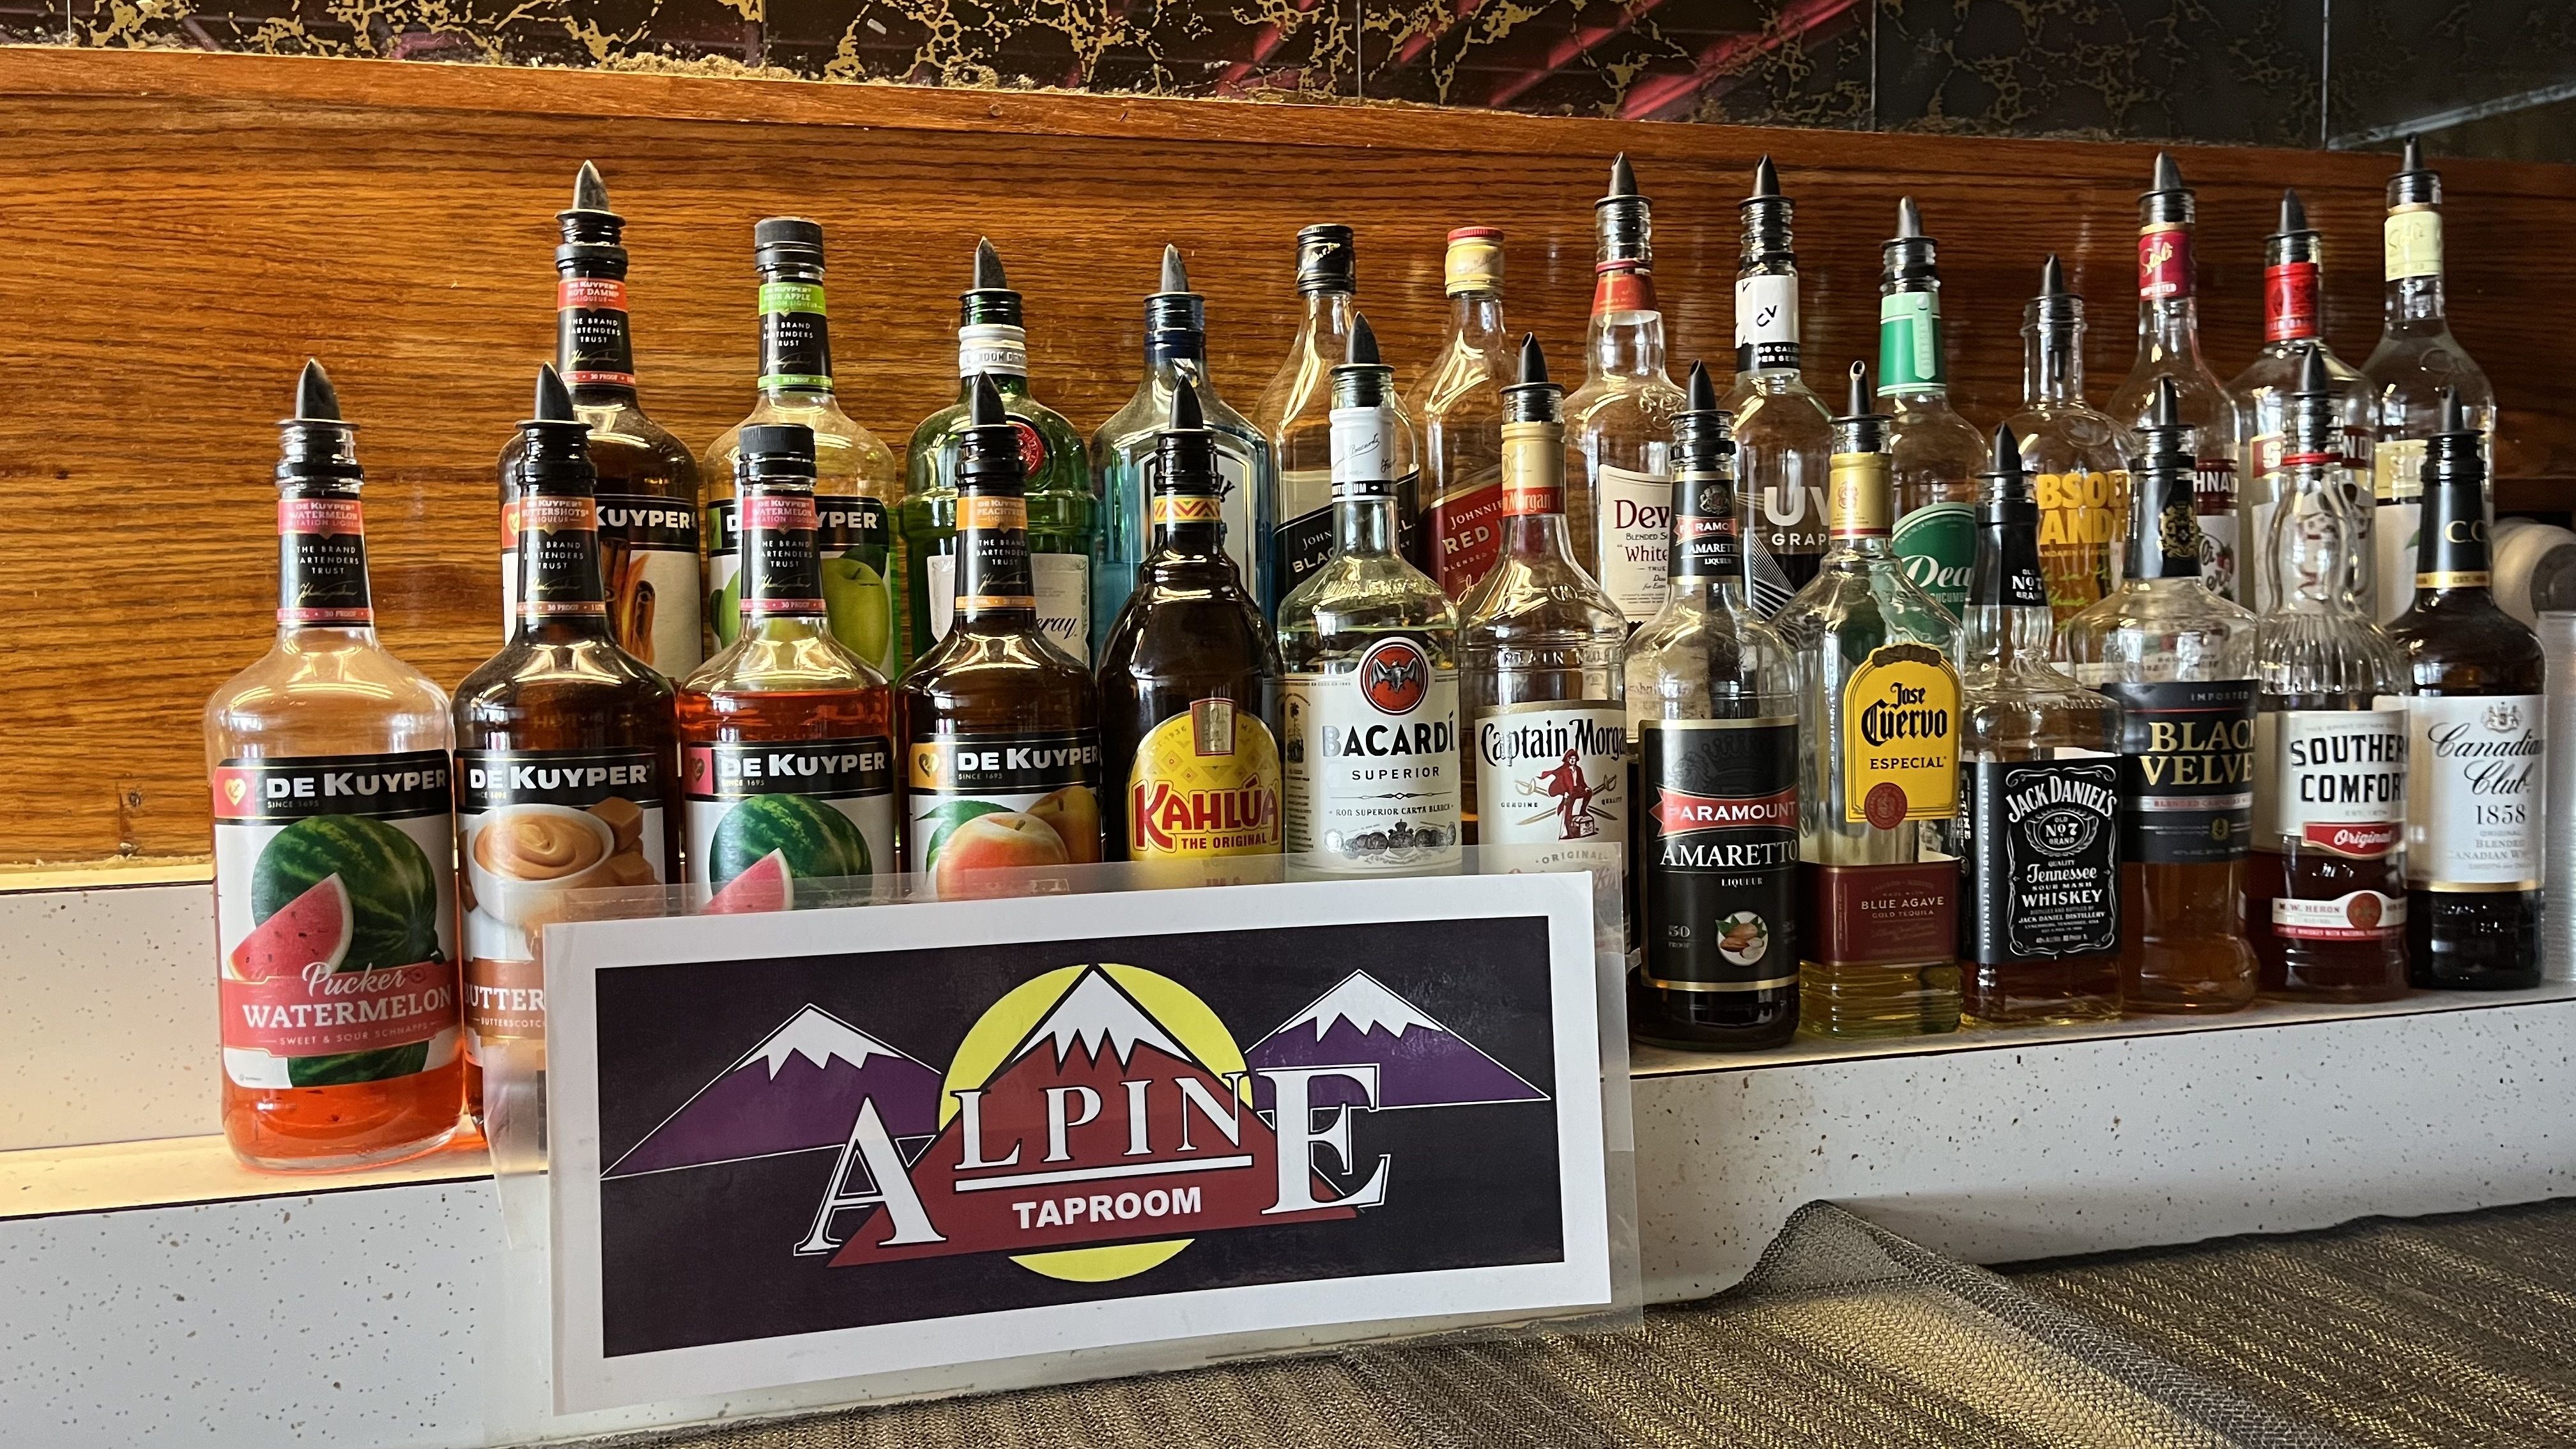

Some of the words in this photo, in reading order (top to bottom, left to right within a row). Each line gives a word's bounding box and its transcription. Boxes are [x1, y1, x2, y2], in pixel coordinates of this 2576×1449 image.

[763, 331, 813, 339] BARTENDERS
[781, 321, 811, 330] BRAND
[752, 508, 812, 516] WATERMELON
[1506, 493, 1551, 512] Morgan
[290, 511, 358, 520] WATERMELON
[596, 505, 691, 529] KUYPER
[817, 511, 875, 529] YPER
[1450, 500, 1503, 530] JOHNNIE
[546, 541, 581, 549] BRAND
[978, 539, 995, 547] THE
[1303, 529, 1332, 551] JOHN
[1442, 526, 1490, 555] RED
[1689, 543, 1738, 554] AMARETT
[1772, 532, 1829, 546] GRAP
[296, 545, 314, 554] THE
[321, 545, 356, 554] BRAND
[524, 551, 584, 560] BTENDERS
[759, 550, 813, 558] ARTENDERS
[1625, 544, 1668, 562] White
[295, 556, 360, 565] ARTENDERS
[538, 562, 567, 570] TRUST
[1292, 548, 1335, 573] BLAC
[1443, 552, 1487, 572] BLENDED
[311, 566, 344, 575] TRUST
[1890, 681, 1926, 708] Jose
[2191, 691, 2249, 702] IMPORTED
[1860, 698, 1947, 747] Cuervo
[1322, 710, 1455, 757] BACARDÍ
[1480, 719, 1568, 767] Captain
[1569, 718, 1627, 761] Morga
[957, 752, 1000, 771] DE
[1007, 744, 1099, 770] KUYPER
[2290, 733, 2408, 767] SOUTHER
[721, 756, 762, 778] DE
[769, 753, 886, 777] KUYPER
[1870, 756, 1944, 769] ESPECIAL
[2138, 753, 2253, 786] VELVE
[470, 769, 503, 789] DE
[510, 765, 648, 790] KUYPER
[1352, 767, 1439, 780] SUPERIOR
[266, 776, 316, 799] DE
[323, 768, 445, 797] KUYPER
[2301, 772, 2407, 803] COMFOR
[1981, 778, 1989, 811] EVERY
[2005, 783, 2049, 823] JACK
[2049, 775, 2117, 818] DANIEL'S
[267, 800, 293, 809] SINCE
[1134, 776, 1279, 849] KAHLÚA
[1335, 808, 1353, 816] RON
[1356, 807, 1399, 816] SUPERIOR
[1401, 806, 1427, 815] CARTA
[1429, 803, 1450, 813] BLANCA
[1667, 801, 1797, 822] PARAMOUNT
[2475, 802, 2526, 825] 1858
[1981, 815, 1989, 840] DROP
[2069, 823, 2079, 832] 7
[1181, 838, 1206, 849] THE
[1213, 832, 1266, 848] ORIGINAL
[2048, 837, 2076, 845] BRAND
[2334, 829, 2391, 849] Original
[1542, 850, 1604, 864] ORIGINAL
[1659, 839, 1798, 868] AMARETTO
[1982, 846, 1990, 872] MADE
[2450, 850, 2508, 860] ANADIAN
[1721, 877, 1763, 887] LIQUEUR
[1982, 877, 1989, 888] IN
[2027, 864, 2097, 884] Tennessee
[1861, 900, 1896, 910] BLUE
[1901, 896, 1945, 908] AGAVE
[2021, 889, 2103, 907] WHISKEY
[2065, 911, 2106, 920] DISTILLERY
[2305, 904, 2341, 914] HERON
[1668, 924, 1690, 938] 50
[1982, 893, 1991, 950] TENNESSEE
[302, 961, 407, 998] Pucker
[242, 983, 452, 1029] WATERMELON
[464, 983, 545, 1011] BUTTER
[481, 1016, 542, 1028] BUTTERSCOTC
[280, 1035, 316, 1046] SWEET
[323, 1035, 330, 1044] &
[336, 1031, 369, 1042] SOUR
[374, 1022, 429, 1039] SCHNAPPS
[792, 1062, 1392, 1257] ALPINE
[1012, 1186, 1202, 1230] TAPROOM
